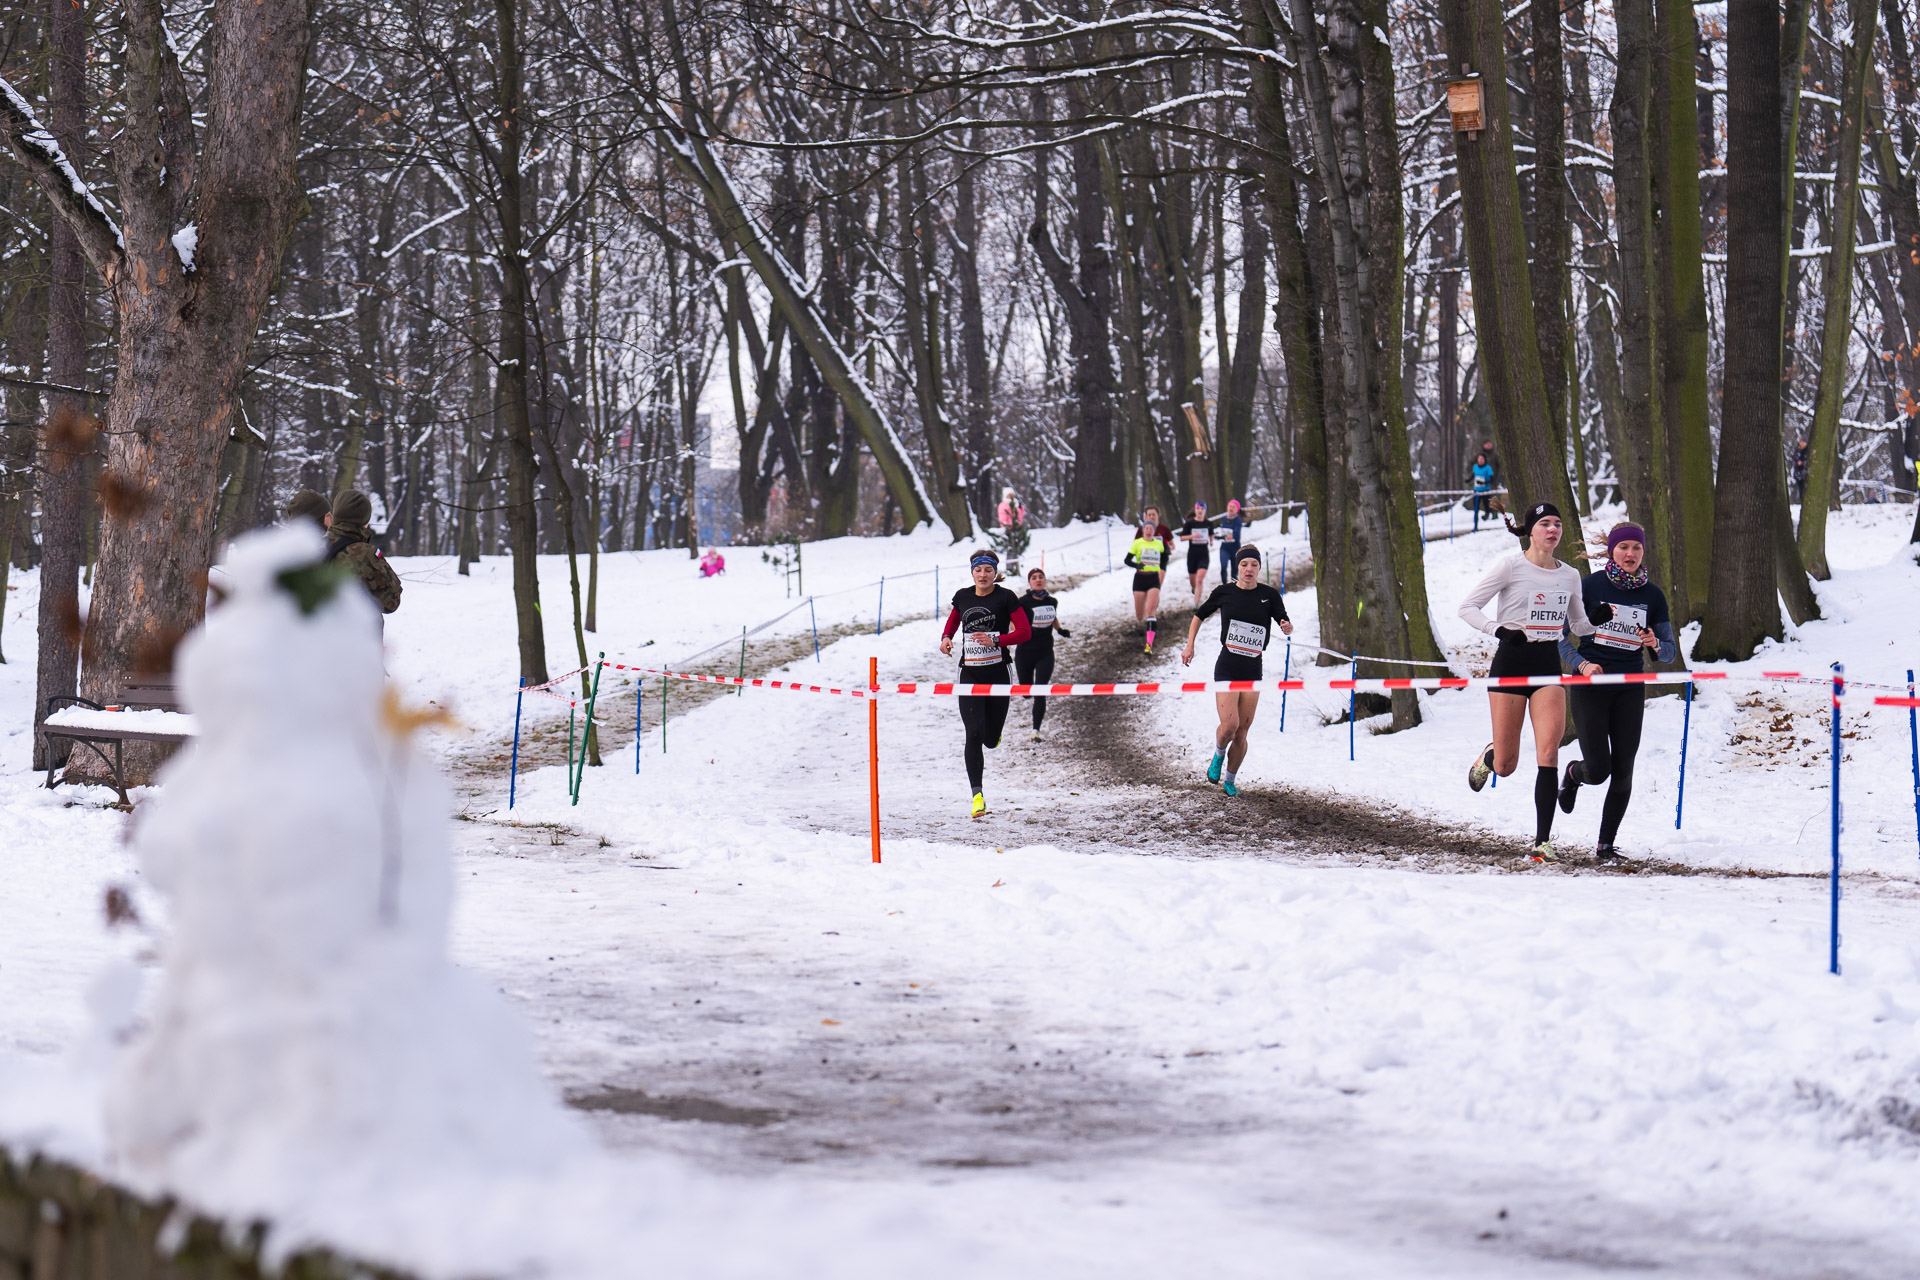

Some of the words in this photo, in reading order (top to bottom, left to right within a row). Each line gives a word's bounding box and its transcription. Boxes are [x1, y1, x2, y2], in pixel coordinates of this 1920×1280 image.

[1632, 610, 1638, 619] 5
[1250, 626, 1264, 634] 296
[1228, 632, 1262, 647] BAZUŁKA
